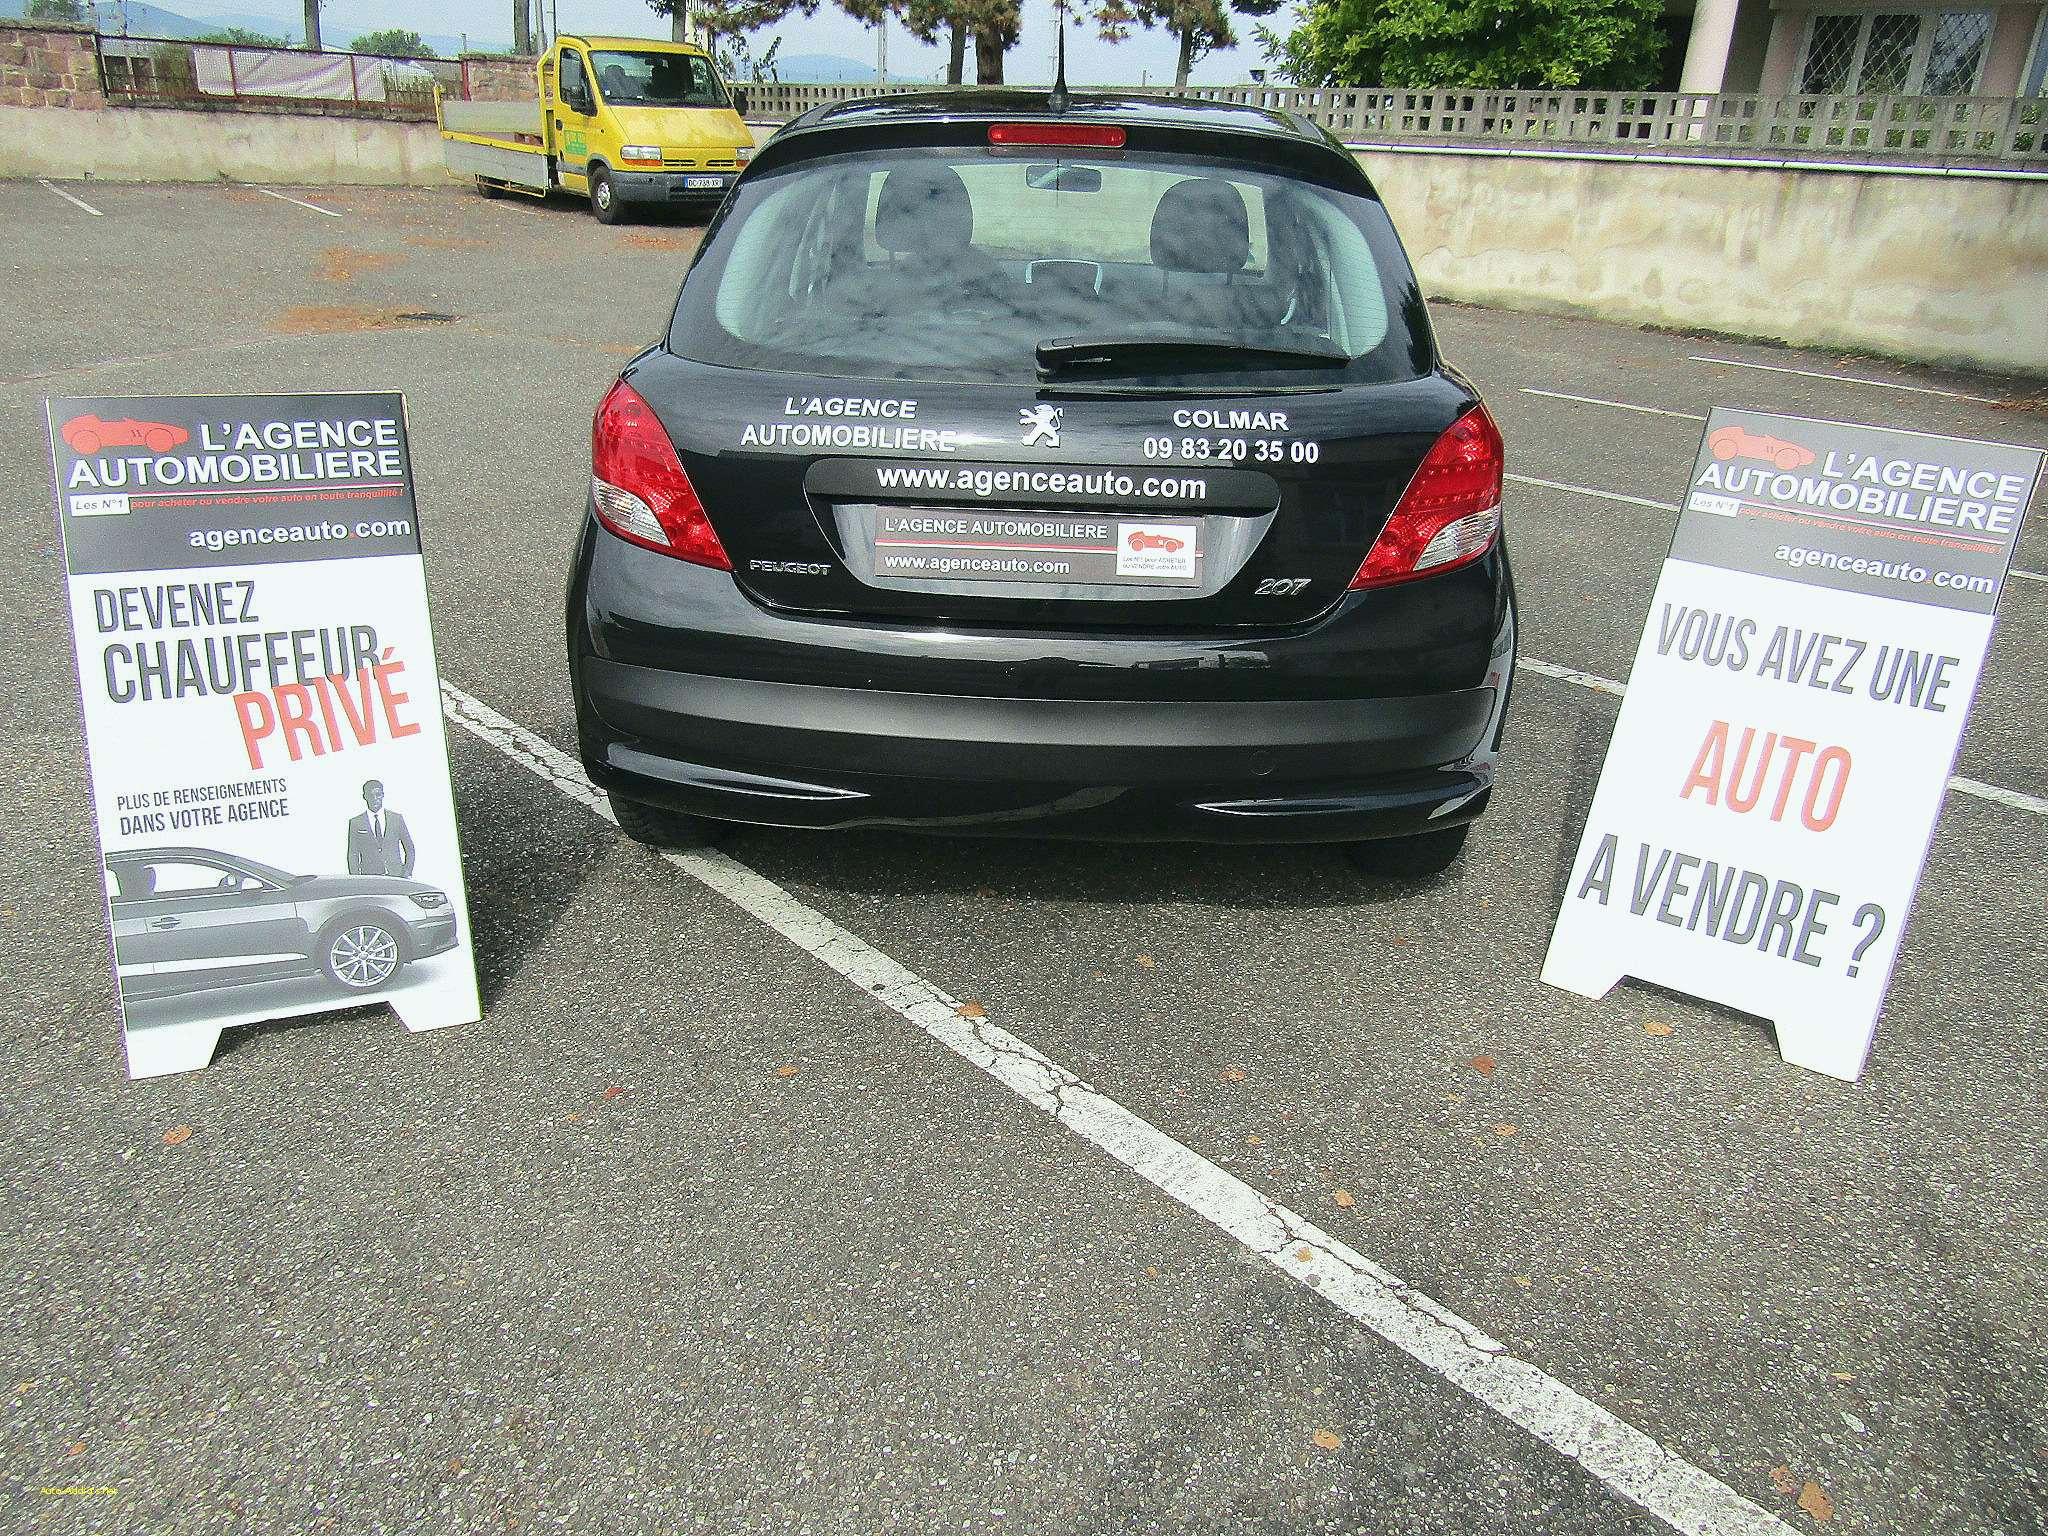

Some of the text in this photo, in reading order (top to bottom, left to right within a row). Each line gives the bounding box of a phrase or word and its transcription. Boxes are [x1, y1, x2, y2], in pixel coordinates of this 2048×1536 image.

[784, 397, 918, 419] L'AGENCE
[1173, 409, 1289, 431] COLMAR
[200, 419, 399, 451] L'AGENCE
[740, 424, 957, 452] AUTOMOBILIERE
[1143, 437, 1319, 463] 09 83 20 35 00
[69, 450, 403, 488] AUTOMOBILIERE
[876, 467, 1206, 499] www.agenceauto.com
[1822, 450, 2025, 504] L'AGENCE
[75, 502, 98, 510] Les
[131, 500, 157, 510] pour
[159, 498, 197, 508] acheter
[216, 495, 249, 504] vendre
[253, 495, 278, 503] votre
[282, 494, 303, 502] auto
[1695, 462, 2017, 534] AUTOMOBILIERE
[190, 518, 411, 551] agenceauto.com
[885, 517, 1108, 539] L'AGENCE AUTOMOBILIERE
[750, 559, 832, 576] PEUGEOT
[885, 554, 1070, 574] www.agenceauto.com
[1774, 544, 1994, 594] agenceauto.com
[1254, 577, 1312, 596] 207
[94, 581, 258, 633] DEVENEZ
[103, 625, 381, 704] CHAUFFEUR
[1657, 603, 1959, 713] VOUS AVEZ UNE
[233, 647, 421, 770] PRIVÉ
[1680, 720, 1852, 832] AUTO
[117, 778, 287, 811] PLUS DE RENSEIGNEMENTS
[120, 798, 290, 836] DANS VOTRE AGENCE
[1577, 833, 1886, 978] A VENDRE ?
